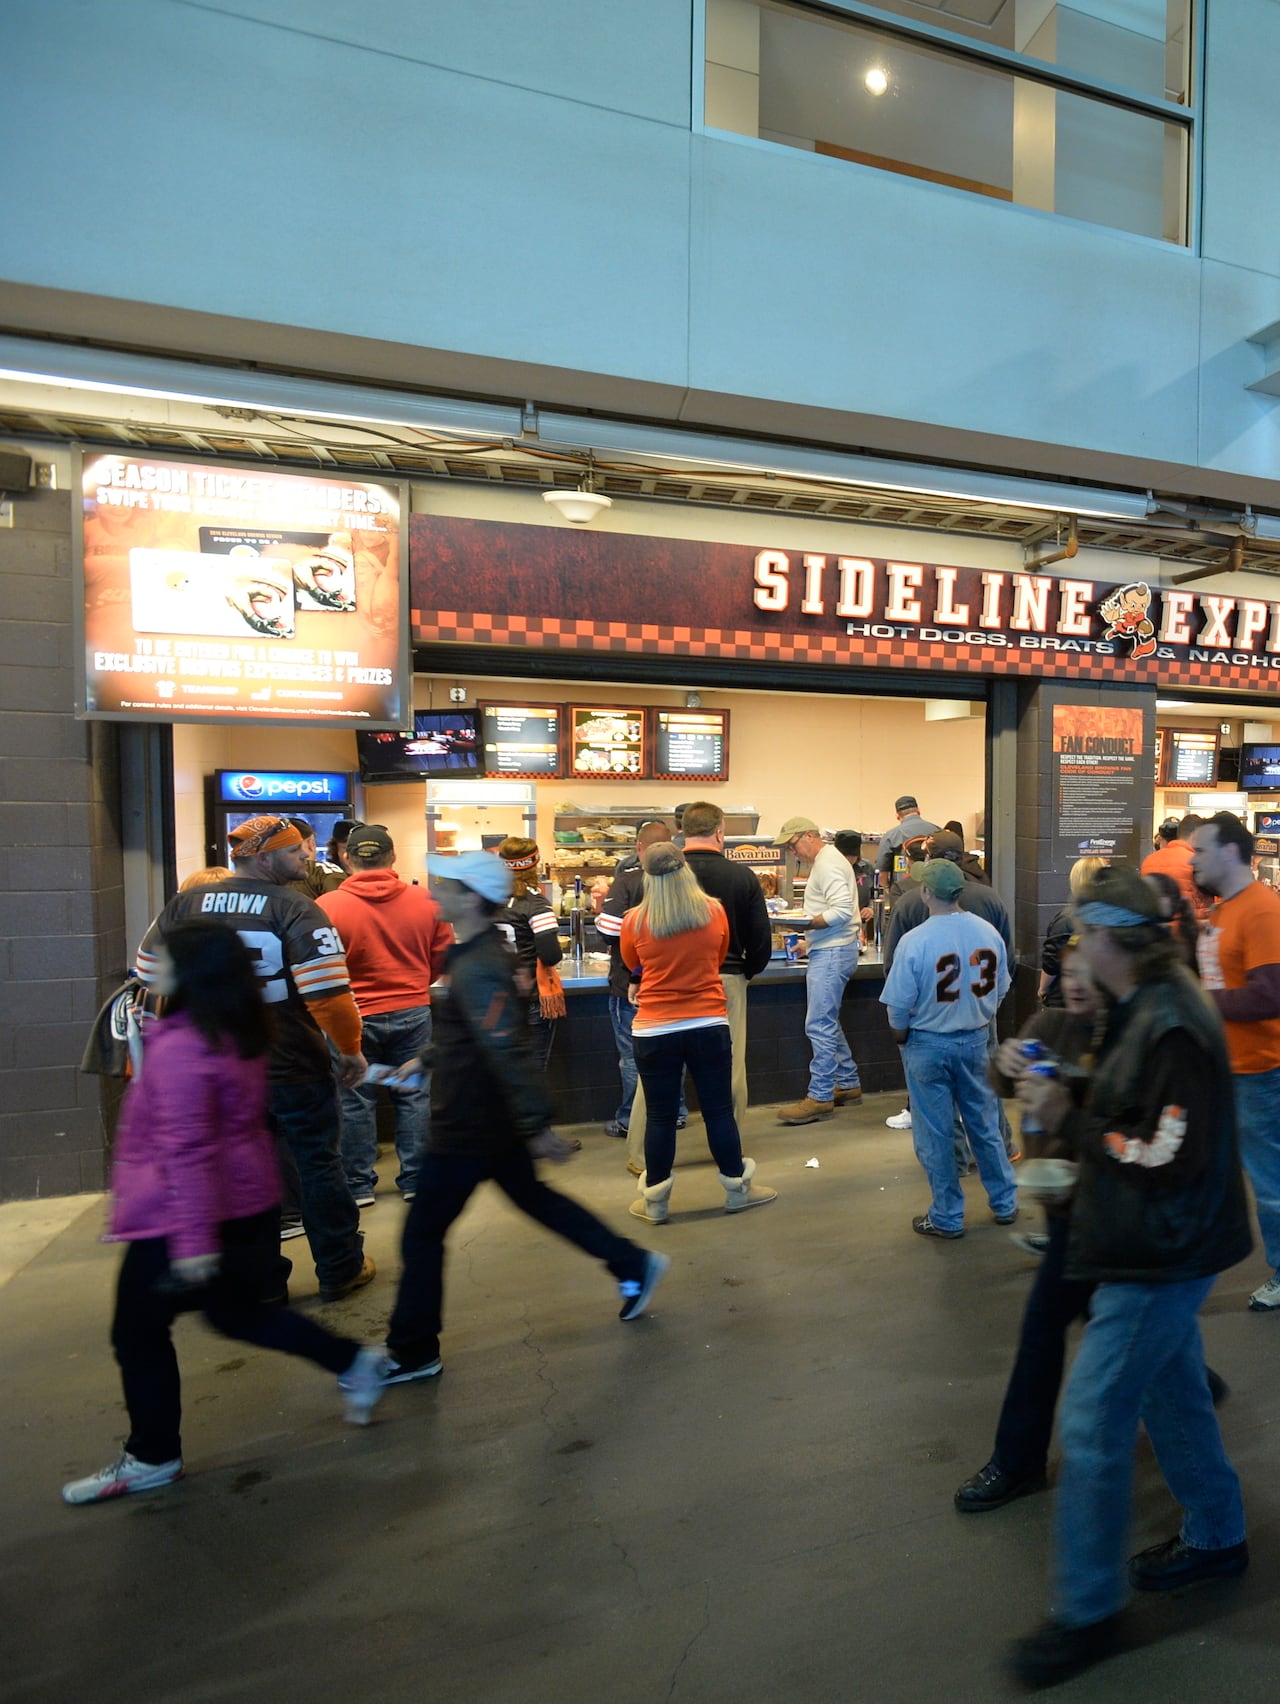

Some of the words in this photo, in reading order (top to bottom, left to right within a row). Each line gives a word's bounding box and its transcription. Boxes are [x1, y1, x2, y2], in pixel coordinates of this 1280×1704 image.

[94, 461, 188, 494] SEASON
[753, 549, 1094, 637] SIDELINE
[846, 622, 916, 639] HOT
[919, 627, 1014, 648] DOGS,
[1019, 636, 1115, 654] BRATS
[1156, 647, 1176, 659] &
[347, 667, 392, 685] PRIZES
[1061, 735, 1082, 752] FAN
[1086, 737, 1135, 754] CONDUCT
[268, 778, 329, 796] pepsi
[725, 848, 781, 861] Bavarian
[201, 893, 268, 915] BROWN
[936, 949, 998, 1004] 23
